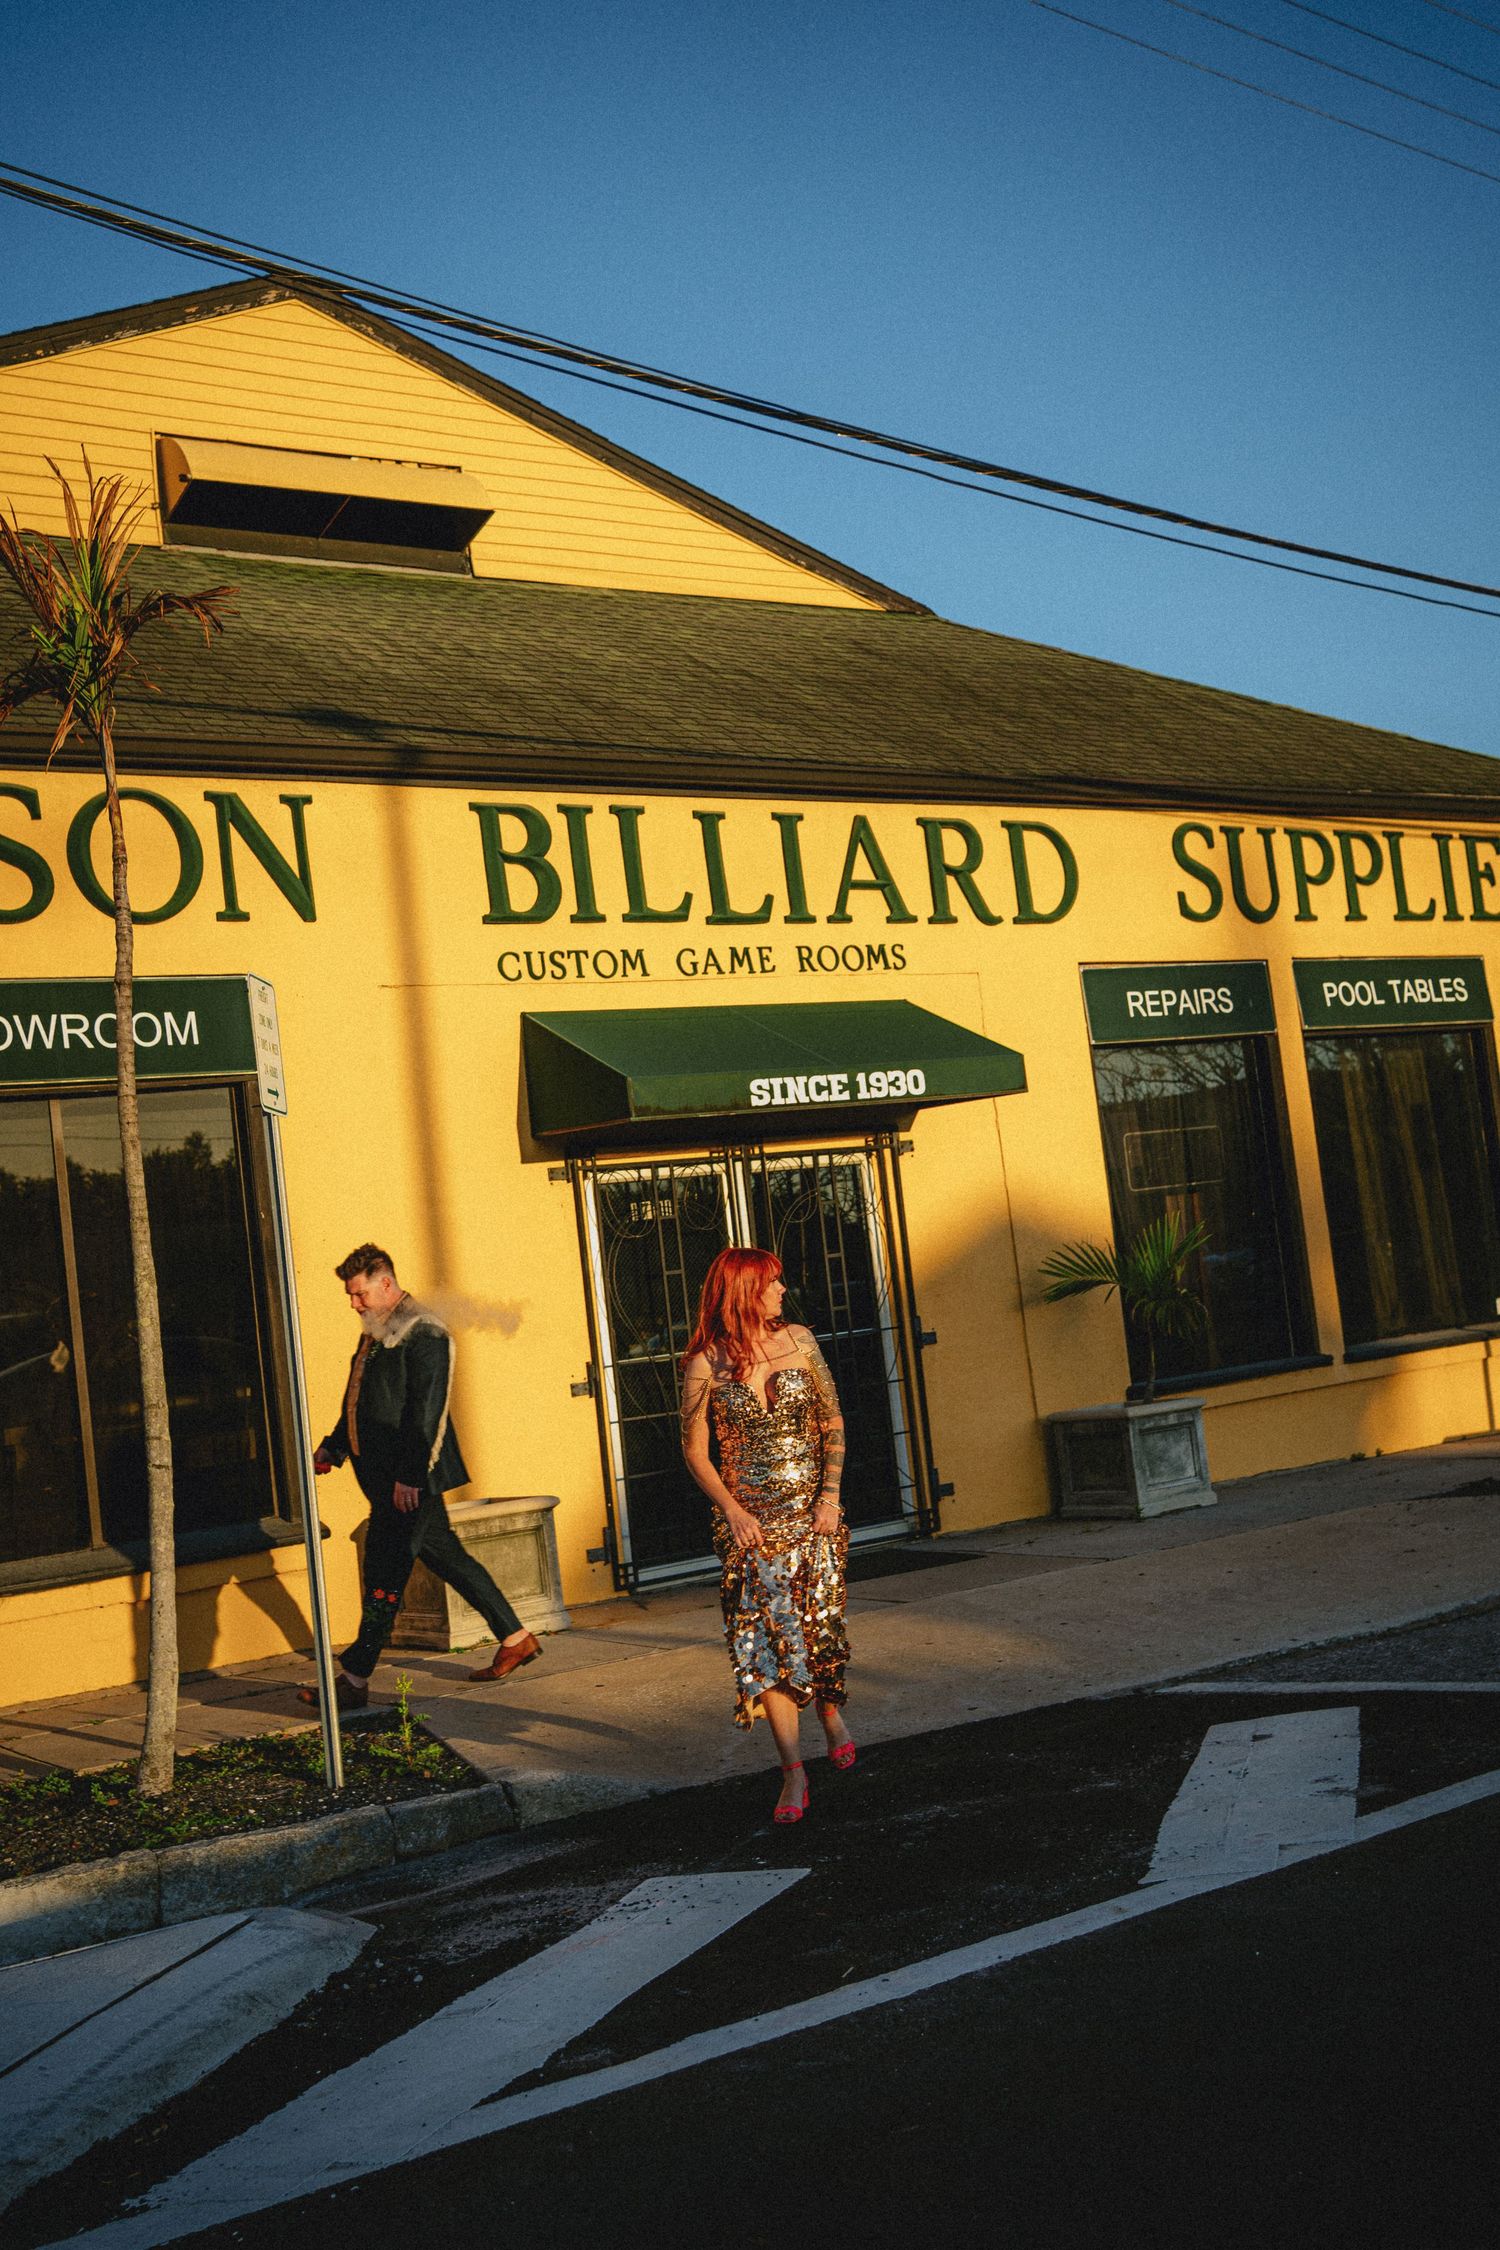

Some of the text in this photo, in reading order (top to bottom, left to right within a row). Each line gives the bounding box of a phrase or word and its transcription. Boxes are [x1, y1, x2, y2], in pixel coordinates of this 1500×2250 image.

[468, 802, 1080, 926] BILLIARD
[1171, 821, 1500, 925] SUPPLIE
[497, 943, 907, 982] CUSTOM GAME ROOMS
[1126, 987, 1234, 1018] REPAIRS
[1322, 977, 1469, 1007] POOL TABLES
[749, 1068, 926, 1107] SINCE 1930
